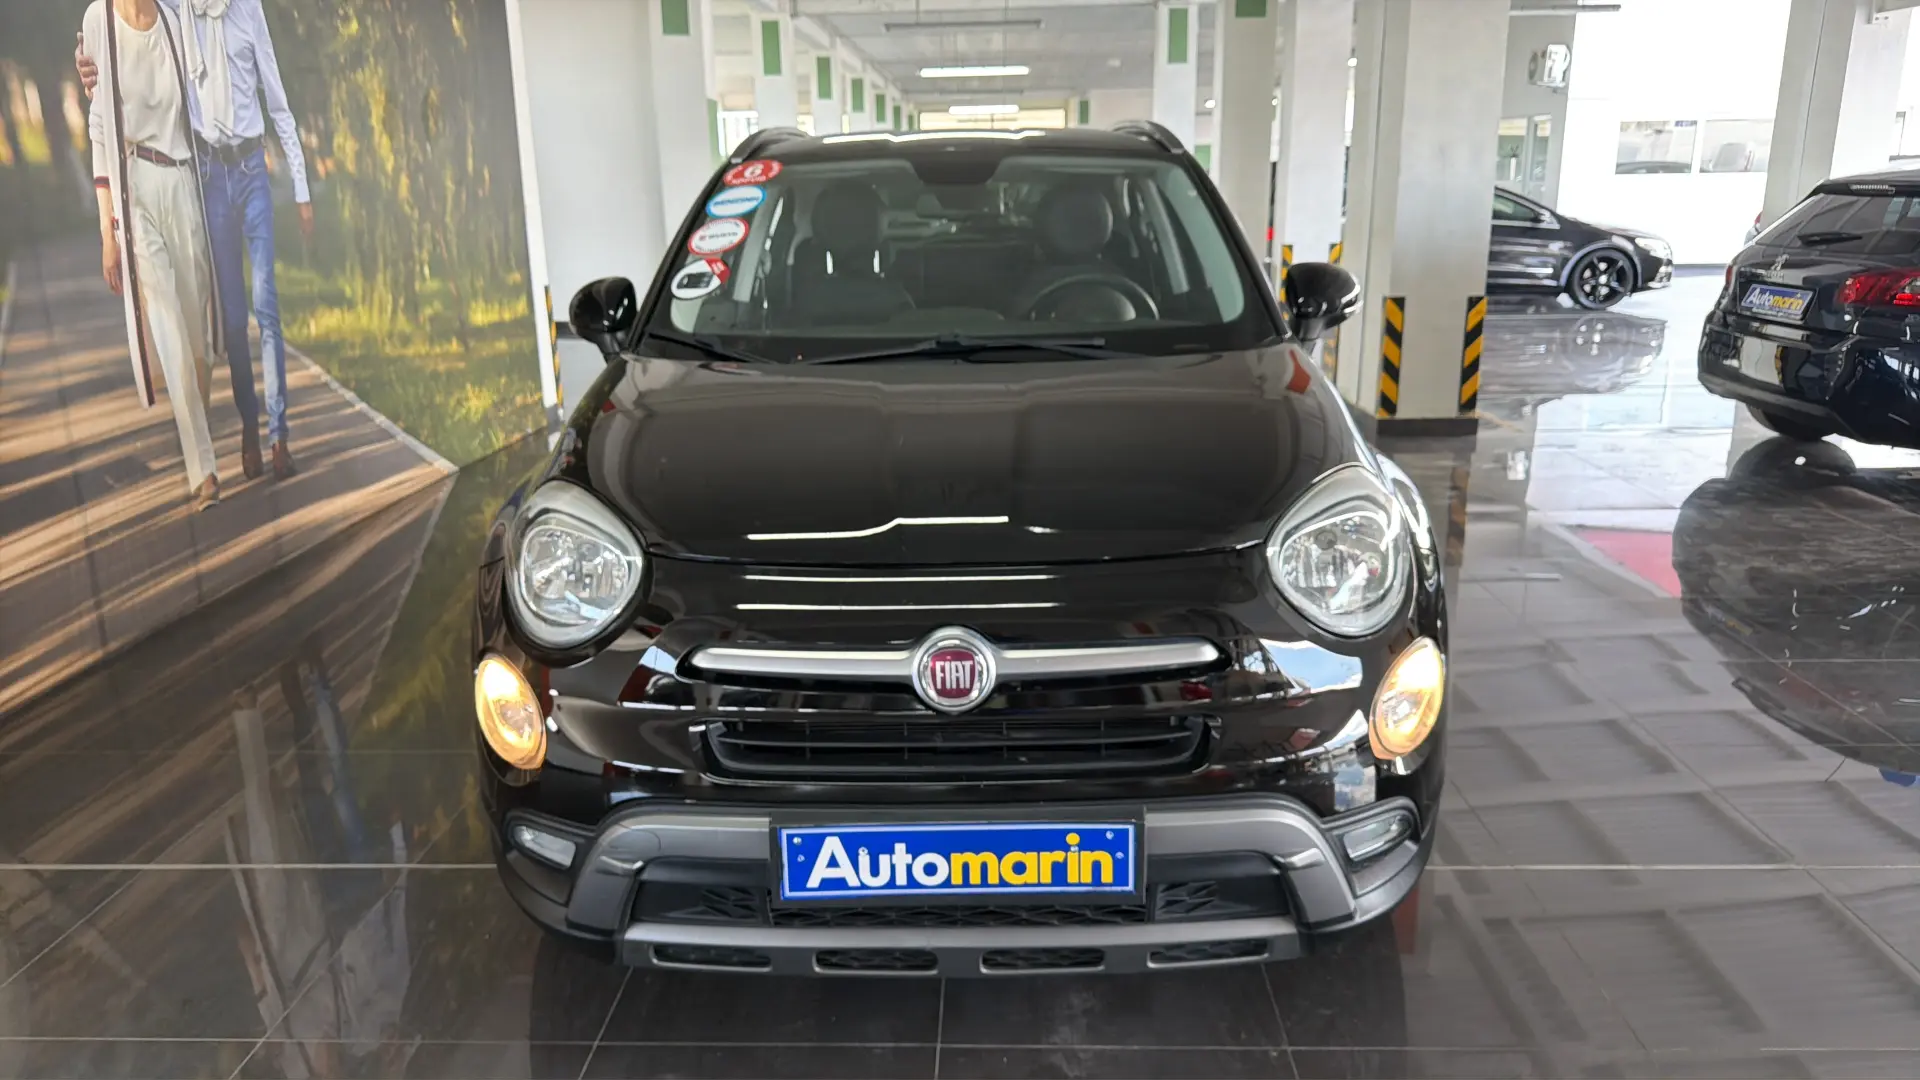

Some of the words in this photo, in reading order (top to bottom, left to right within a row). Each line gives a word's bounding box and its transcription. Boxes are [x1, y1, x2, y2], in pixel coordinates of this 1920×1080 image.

[1746, 287, 1804, 311] Automarin
[935, 660, 974, 690] FIAT
[806, 832, 1114, 888] Automarin
